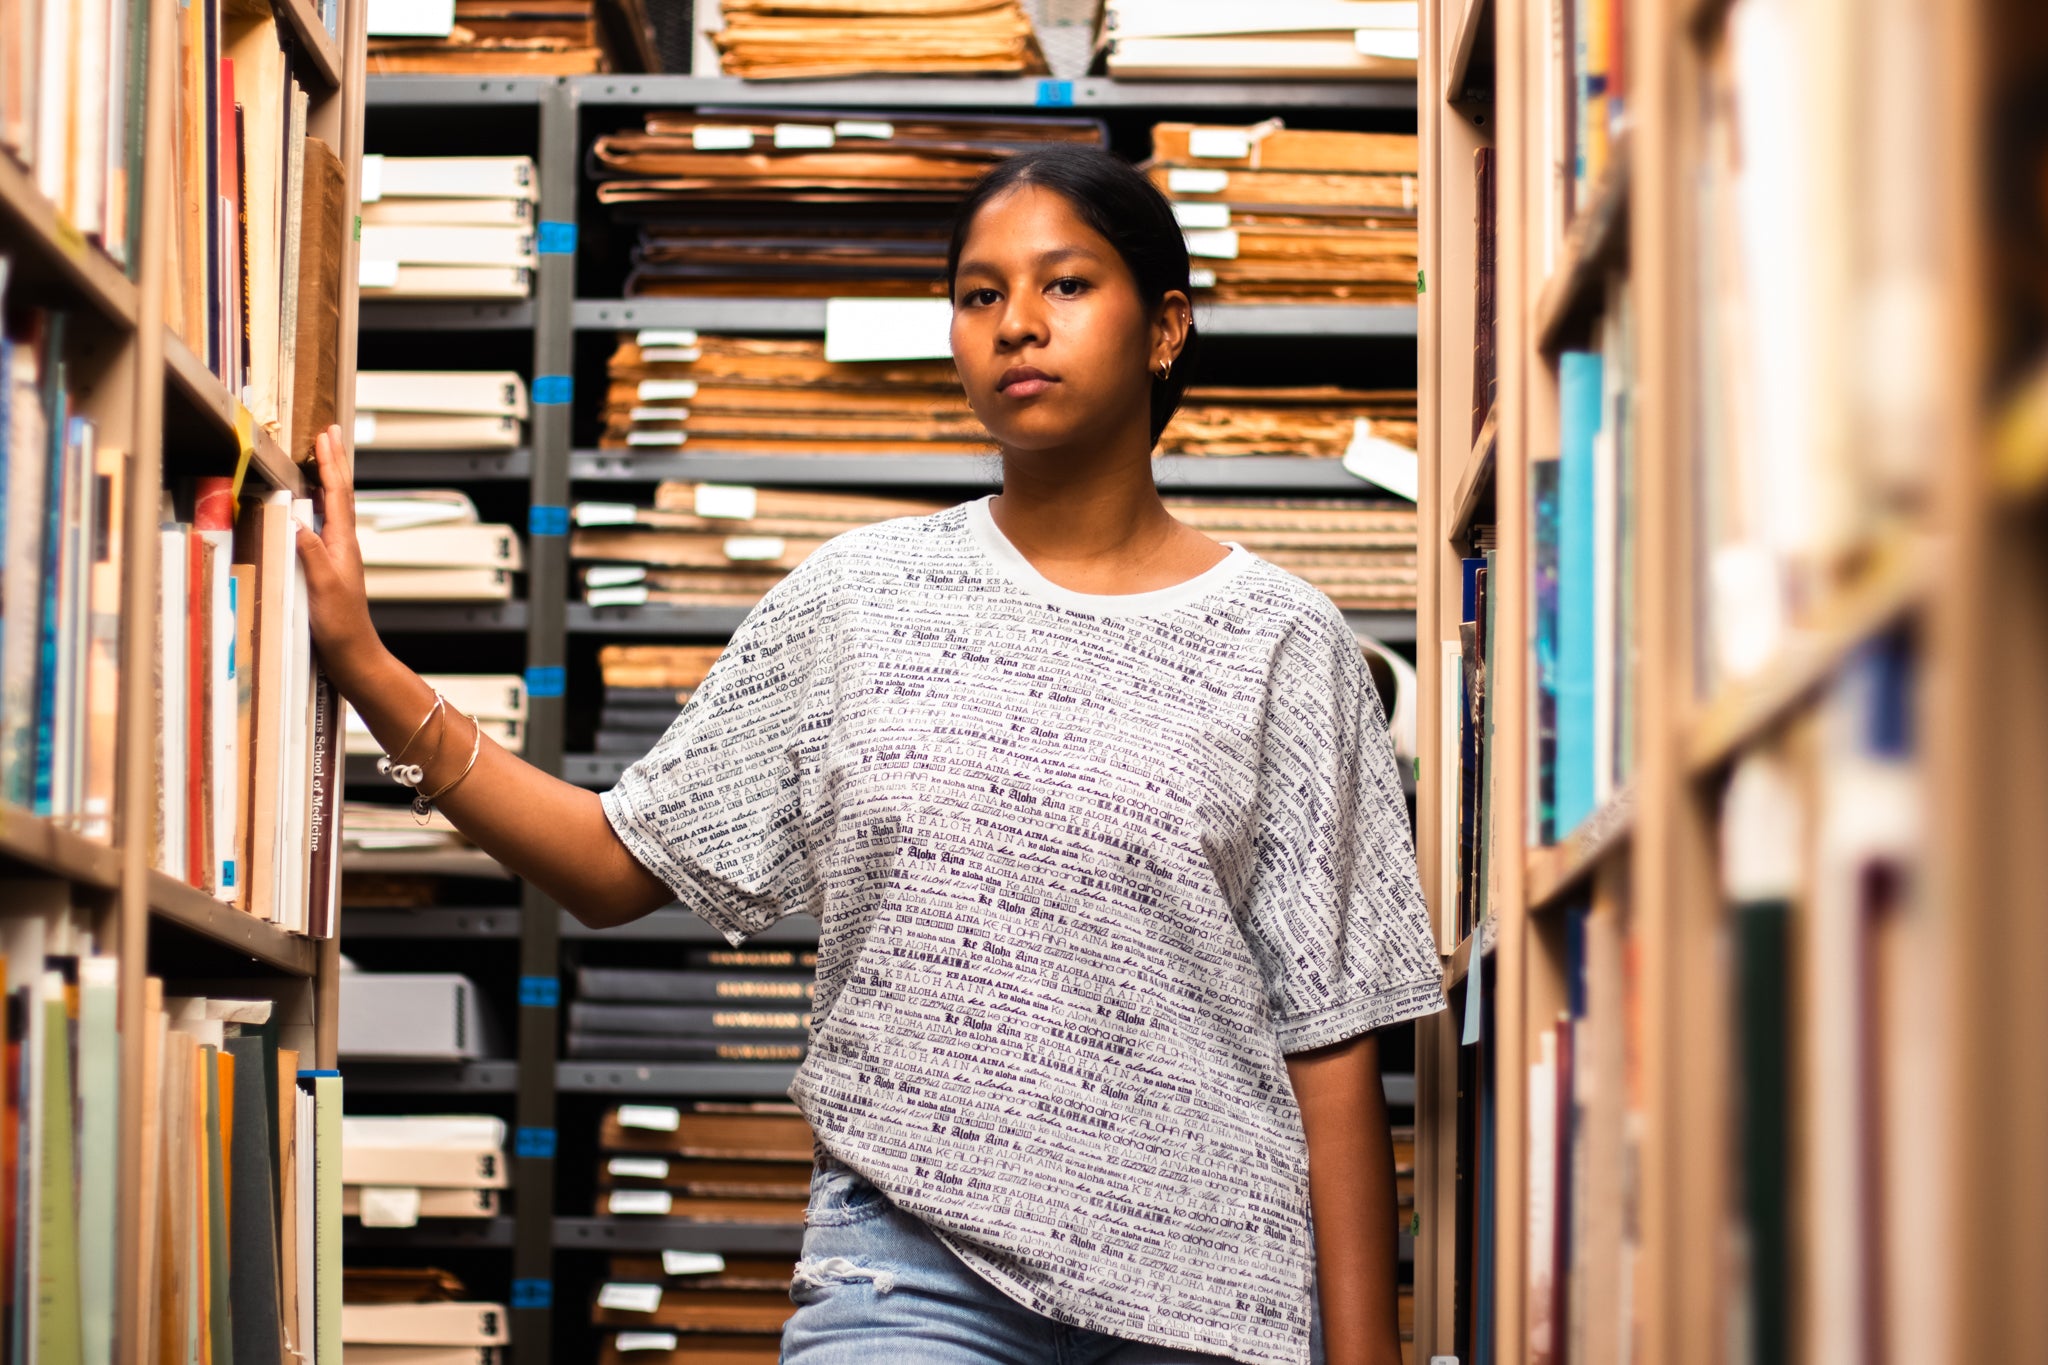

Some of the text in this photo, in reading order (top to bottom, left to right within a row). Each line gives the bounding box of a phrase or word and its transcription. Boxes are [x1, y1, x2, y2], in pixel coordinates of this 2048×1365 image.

[926, 574, 953, 583] Aloha
[958, 576, 982, 584] Aina
[1223, 621, 1250, 635] Aloha
[1256, 628, 1279, 639] Aina
[912, 631, 940, 640] Aloha
[945, 634, 968, 643] Aina
[987, 639, 1025, 653] ALOHA
[1027, 646, 1048, 656] AINA
[1046, 632, 1078, 643] ALOHA
[1081, 640, 1104, 651] AINA
[962, 652, 989, 663] Aloha
[995, 656, 1018, 667] Aina
[1014, 671, 1035, 679] aloha
[894, 688, 921, 697] Aloha
[925, 690, 949, 700] Aina
[1048, 690, 1076, 704] Aloha
[1081, 698, 1105, 711] Aina
[1200, 680, 1228, 697] Aloha
[1231, 689, 1256, 703] Aina
[316, 698, 327, 733] Burns
[314, 736, 325, 777] School
[1030, 726, 1059, 739] Aloha
[1063, 732, 1088, 744] Aina
[1104, 744, 1138, 758] ALOHA
[1141, 755, 1165, 767] AINA
[1007, 749, 1038, 762] ALOHA
[1041, 758, 1065, 768] AINA
[1055, 769, 1077, 778] aloha
[1079, 774, 1096, 783] aina
[313, 779, 324, 796] of
[659, 799, 686, 815] Aloha
[690, 789, 714, 803] Aina
[311, 796, 323, 852] Medicine
[709, 828, 730, 840] aloha
[732, 822, 747, 832] aina
[1008, 788, 1037, 804] Aloha
[1041, 797, 1066, 810] Aina
[1084, 809, 1119, 825] ALOHA
[1122, 821, 1147, 835] AINA
[1171, 841, 1206, 857] aloha
[908, 846, 936, 860] Aloha
[941, 853, 964, 865] Aina
[985, 865, 1018, 880] ALOHA
[1020, 874, 1044, 886] AINA
[1145, 860, 1173, 880] Aloha
[1177, 873, 1199, 890] Aina
[1316, 854, 1335, 882] Aloha
[962, 870, 984, 882] aloha
[985, 877, 1001, 886] aina
[997, 899, 1026, 915] Aloha
[1030, 908, 1054, 921] Aina
[1388, 885, 1408, 911] Aloha
[1409, 912, 1424, 935] Aina
[982, 941, 1011, 958] Aloha
[1015, 950, 1038, 964] Aina
[1056, 962, 1089, 979] ALOHA
[1091, 974, 1115, 986] AINA
[962, 974, 993, 986] ALOHA
[995, 982, 1019, 992] AINA
[1010, 995, 1032, 1005] aloha
[1033, 1000, 1049, 1010] aina
[990, 1002, 1027, 1016] aloha
[1032, 1012, 1063, 1026] aina
[1116, 1009, 1146, 1026] Aloha
[1150, 1018, 1170, 1032] Aina
[962, 1016, 992, 1033] Aloha
[996, 1023, 1021, 1037] Aina
[1100, 1083, 1129, 1100] Aloha
[1134, 1092, 1158, 1109] Aina
[951, 1126, 980, 1142] Aloha
[984, 1134, 1009, 1148] Aina
[1070, 1232, 1096, 1251] Aloha
[1101, 1242, 1124, 1258] Aina
[1255, 1304, 1282, 1320] Aloha
[1287, 1312, 1306, 1326] Aina
